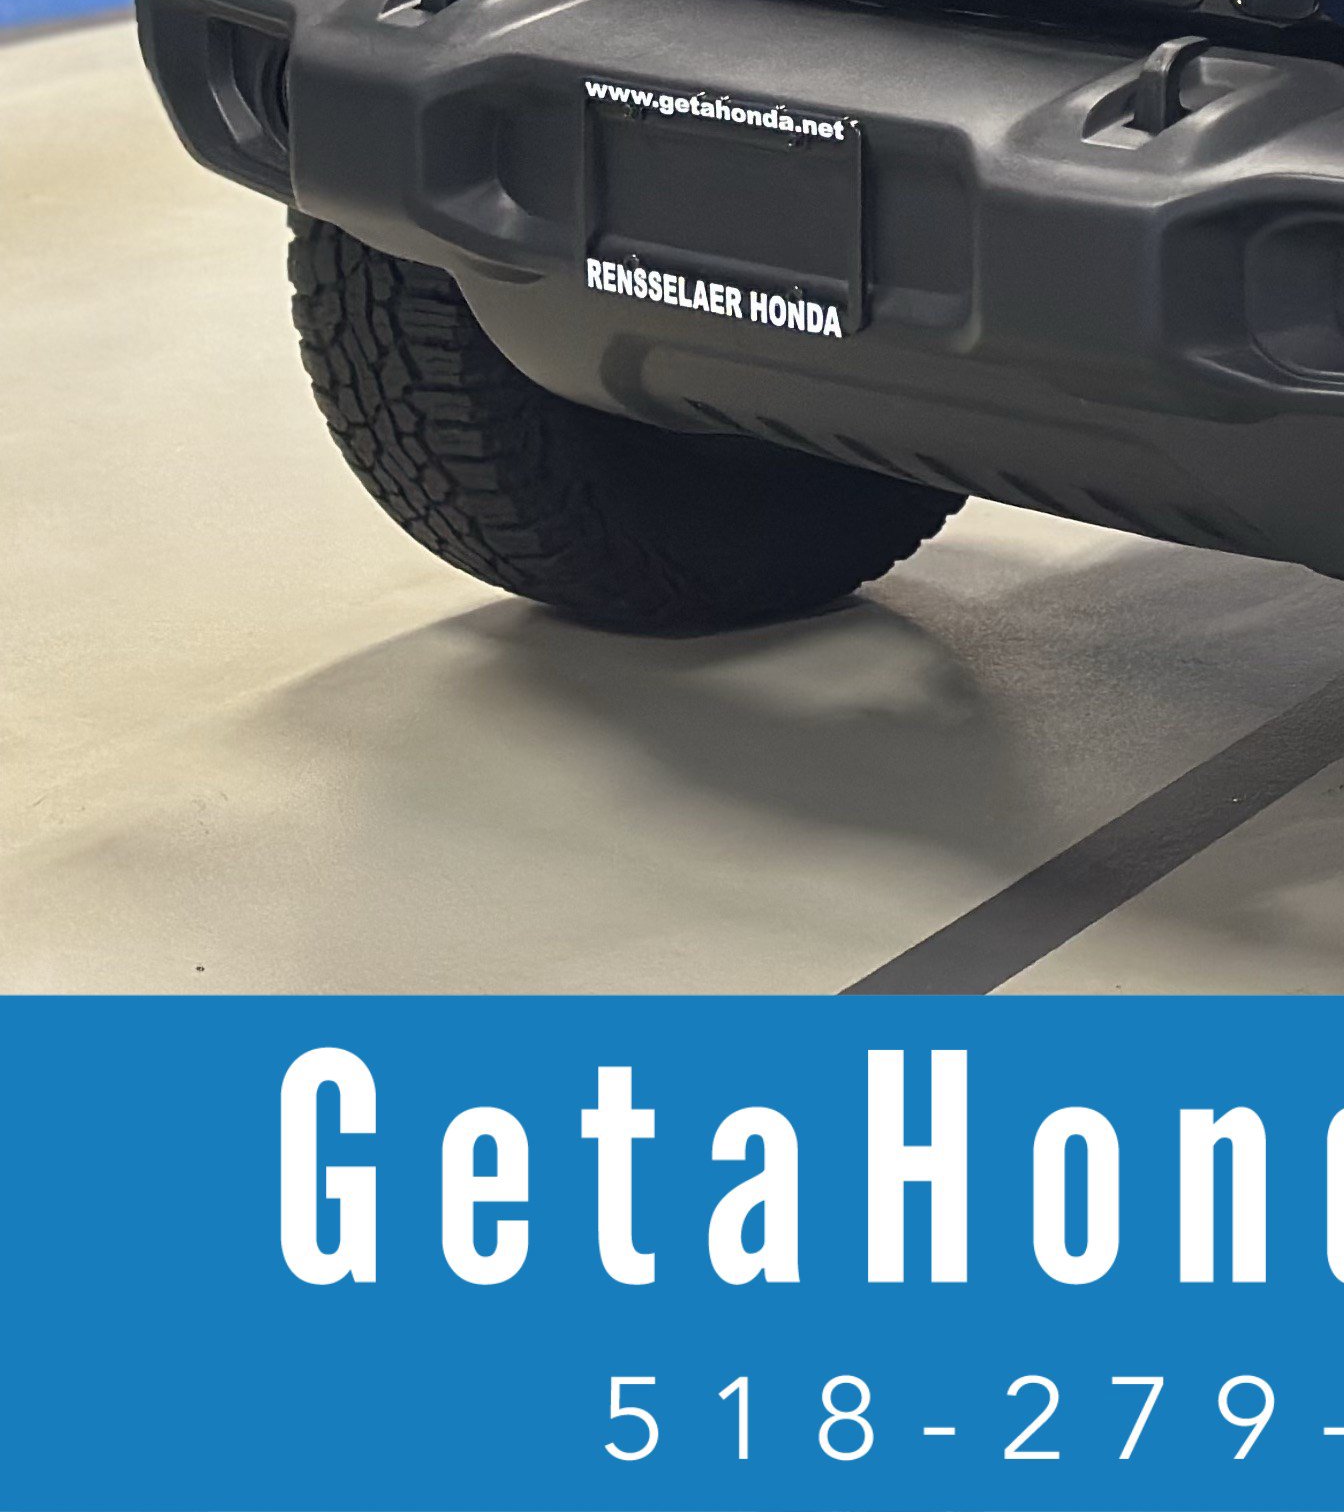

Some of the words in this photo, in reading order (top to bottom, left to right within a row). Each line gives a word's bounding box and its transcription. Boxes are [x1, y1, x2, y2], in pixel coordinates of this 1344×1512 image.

[585, 81, 845, 141] www.getahonda.net
[587, 258, 743, 319] RENSSELAER
[750, 291, 843, 339] HONDA
